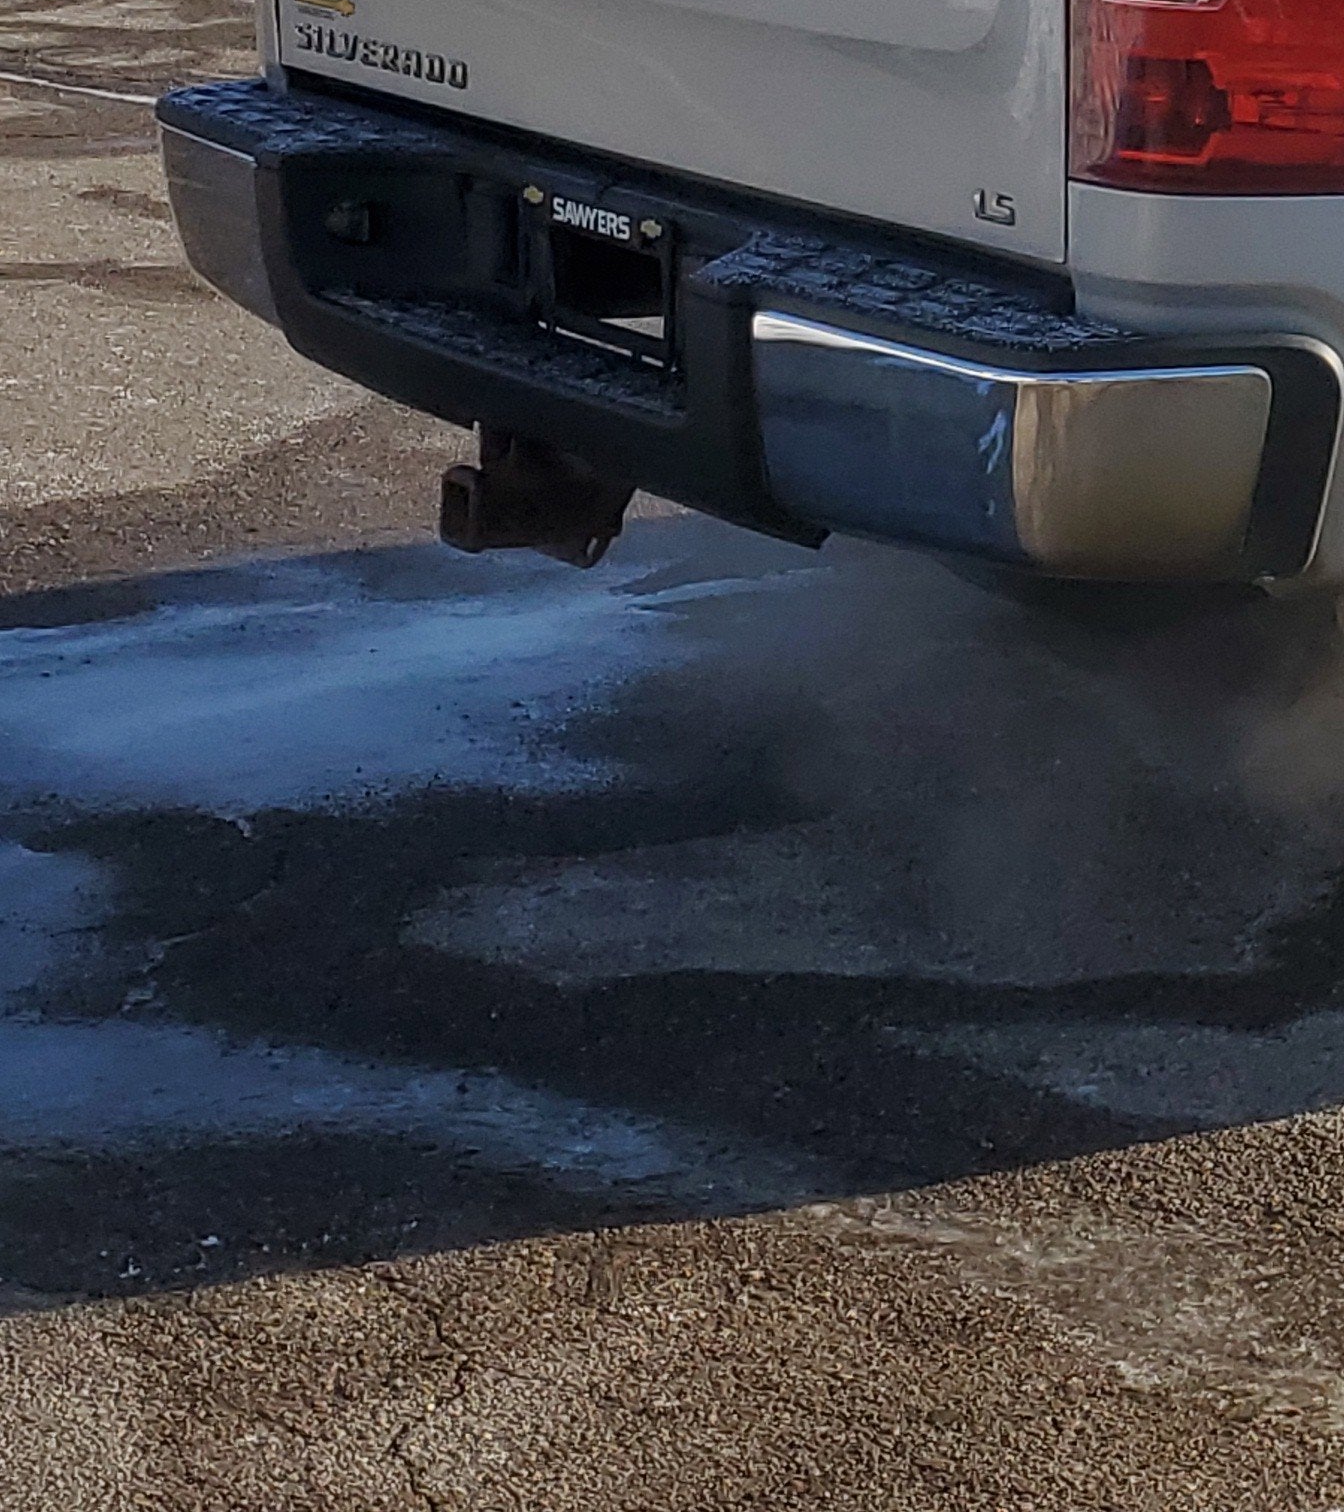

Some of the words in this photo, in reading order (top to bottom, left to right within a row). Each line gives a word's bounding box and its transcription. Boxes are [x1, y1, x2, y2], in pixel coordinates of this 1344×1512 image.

[294, 22, 469, 90] SILVERADO
[552, 196, 631, 240] SAWYERS
[973, 188, 1016, 226] LS
